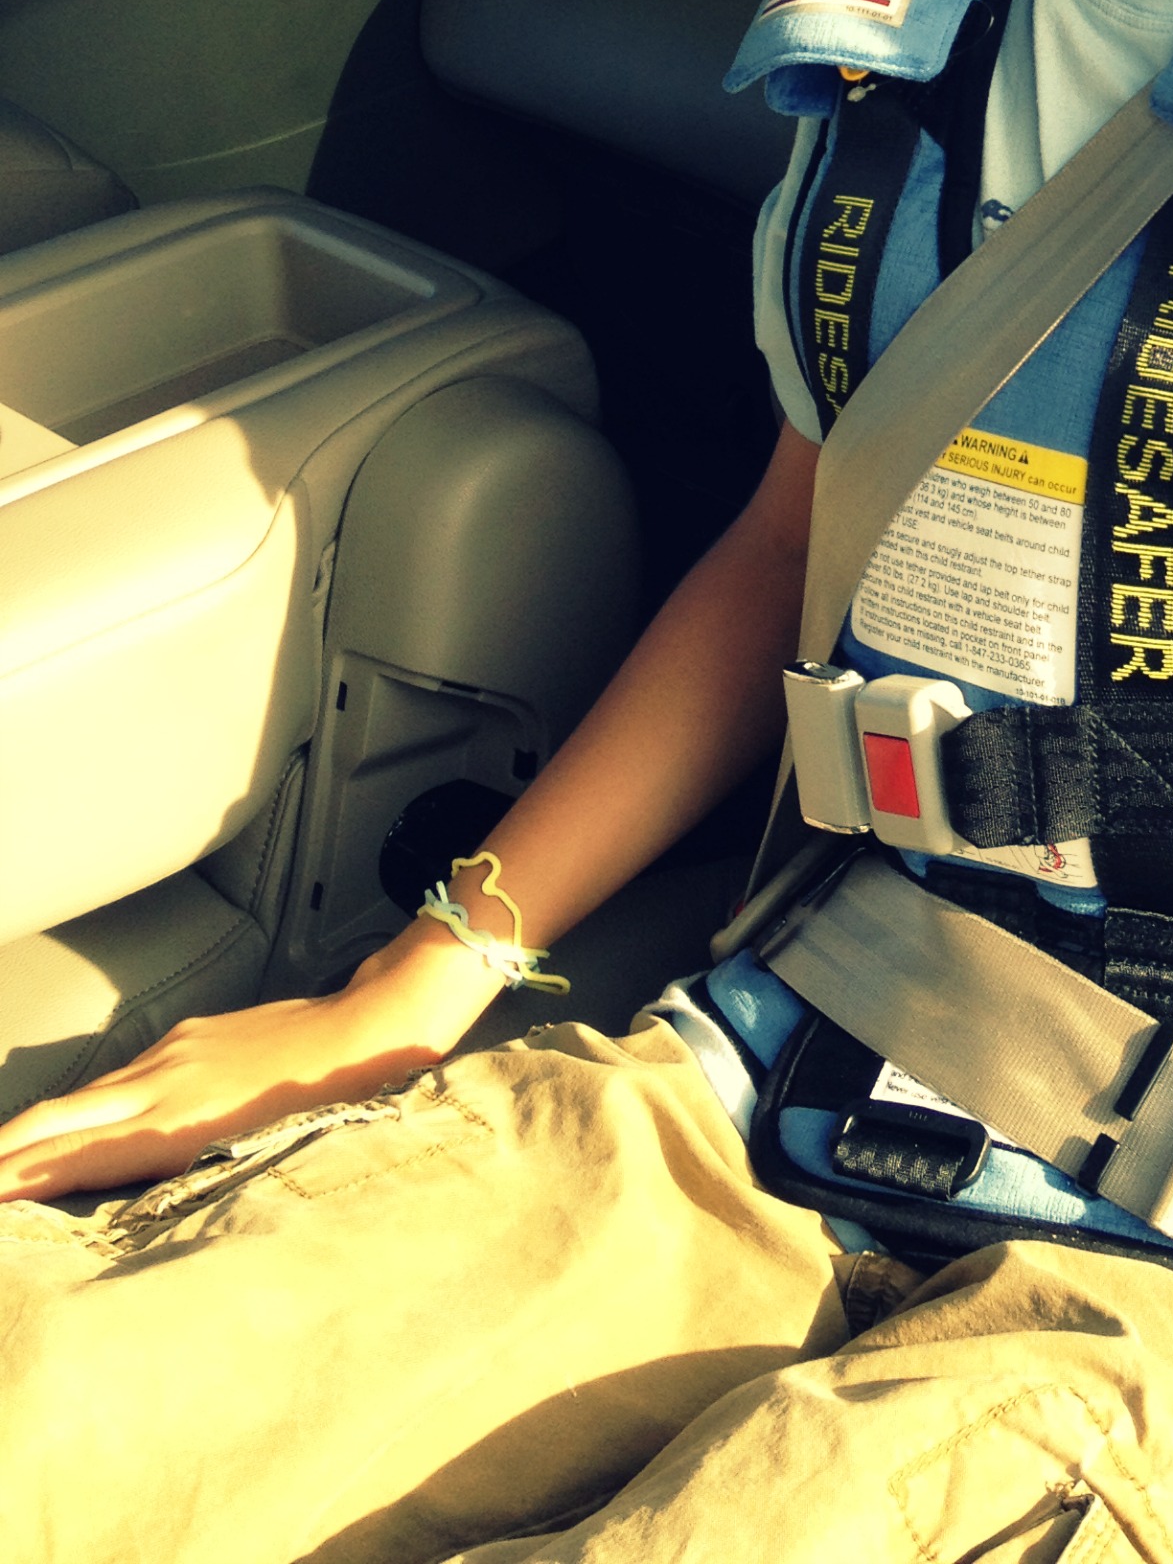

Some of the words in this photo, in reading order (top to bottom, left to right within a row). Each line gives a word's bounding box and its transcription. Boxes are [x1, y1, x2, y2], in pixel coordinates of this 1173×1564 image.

[961, 434, 1016, 460] WARNING
[947, 451, 989, 472] SERIOUS
[991, 463, 1026, 481] INJURY
[1027, 475, 1045, 487] can
[1047, 480, 1077, 494] occur
[930, 498, 944, 509] and
[947, 501, 961, 514] 145
[950, 492, 965, 503] and
[967, 496, 991, 511] whose
[993, 502, 1018, 518] height
[1020, 511, 1027, 520] is
[1028, 512, 1066, 530] between
[951, 477, 966, 490] who
[969, 483, 991, 498] weigh
[992, 489, 1026, 506] between
[1028, 497, 1040, 510] 50
[1041, 503, 1058, 515] and
[1059, 506, 1072, 518] 80
[915, 508, 930, 519] vest
[931, 512, 946, 524] and
[947, 517, 974, 532] vehicle
[975, 524, 993, 538] seat
[994, 528, 1014, 544] belts
[1015, 536, 1046, 553] around
[896, 531, 919, 545] secure
[921, 538, 936, 550] and
[937, 543, 962, 559] snugly
[963, 551, 987, 566] adjust
[989, 558, 1002, 570] the
[1004, 562, 1018, 575] top
[1020, 566, 1046, 581] tether
[1047, 574, 1072, 588] strap
[915, 548, 928, 561] this
[929, 553, 948, 566] child
[896, 584, 914, 596] child
[947, 600, 963, 612] with
[972, 609, 1001, 625] vehicle
[1003, 617, 1022, 630] seat
[928, 568, 961, 586] provided
[962, 579, 977, 591] and
[979, 583, 992, 595] lap
[993, 587, 1010, 600] belt
[1011, 593, 1030, 607] only
[1032, 597, 1044, 608] for
[1046, 601, 1070, 615] child
[943, 584, 959, 598] Use
[960, 590, 973, 603] lap
[974, 596, 990, 607] and
[992, 600, 1029, 618] shoulder
[922, 616, 950, 634] located
[988, 639, 999, 650] on
[1001, 641, 1021, 656] front
[932, 609, 942, 619] on
[944, 612, 958, 625] this
[959, 618, 978, 631] child
[979, 624, 1014, 642] restraint
[1016, 636, 1033, 647] and
[1036, 639, 1044, 650] in
[1048, 641, 1063, 653] the
[971, 659, 984, 671] the
